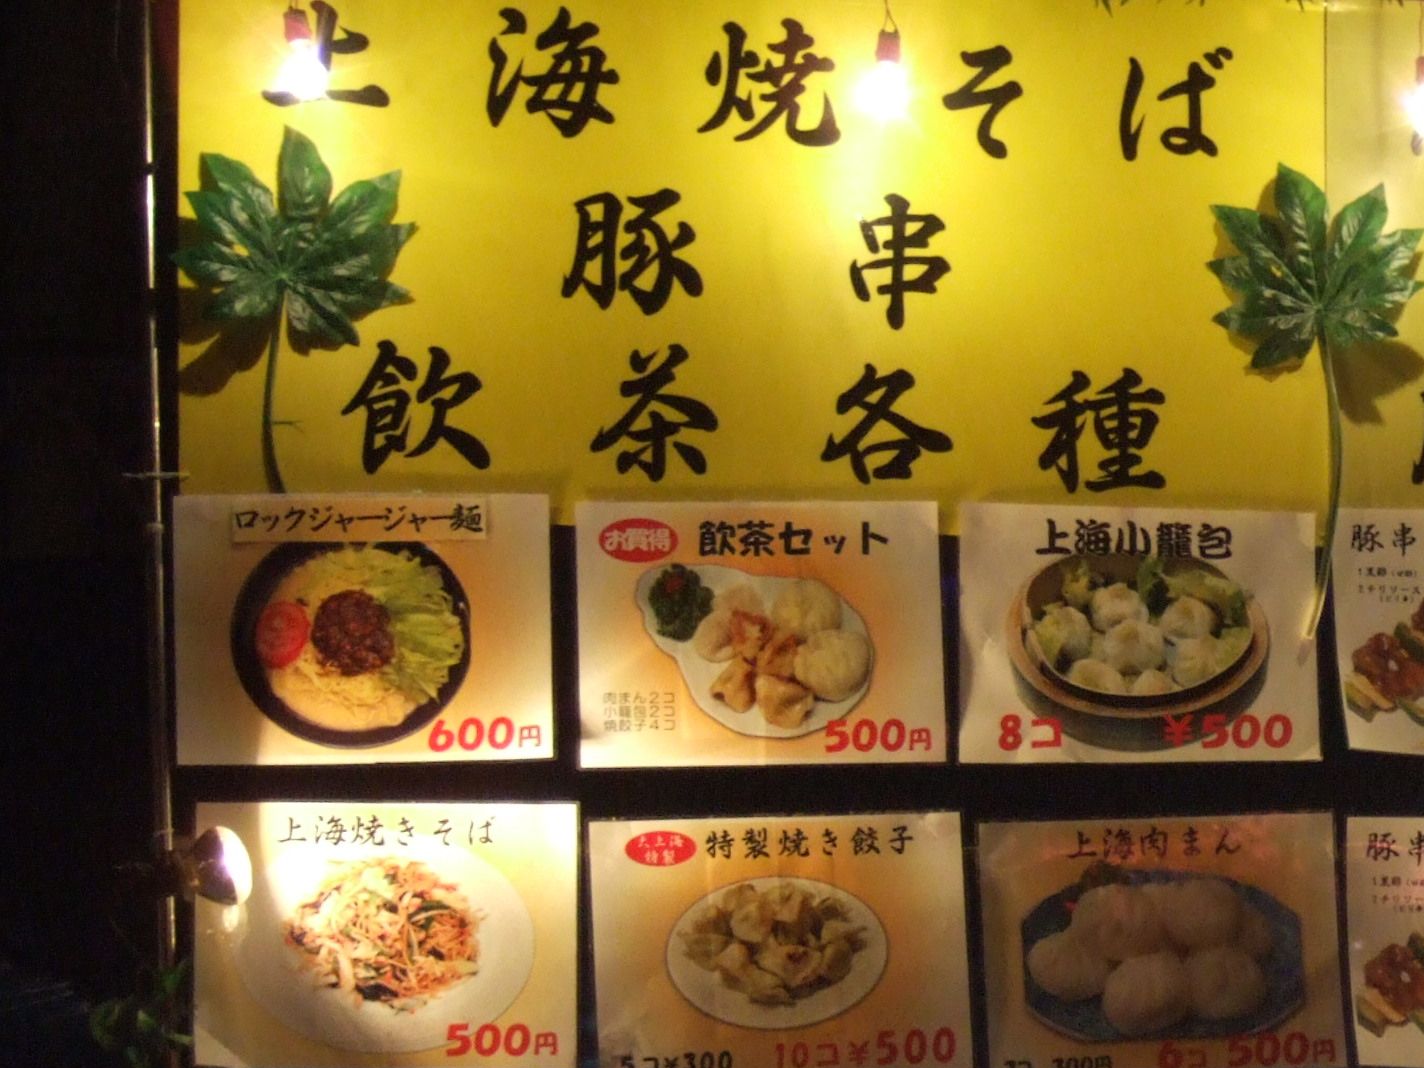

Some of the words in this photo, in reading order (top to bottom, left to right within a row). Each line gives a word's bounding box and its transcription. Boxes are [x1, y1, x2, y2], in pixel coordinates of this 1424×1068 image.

[262, 4, 1233, 162] 上海焼そば
[560, 191, 953, 331] 豚串
[341, 340, 1167, 494] 飲茶各種
[234, 503, 485, 533] ロックジャージャー麺
[698, 520, 889, 557] 飲茶セット
[1036, 518, 1233, 560] 上海小籠包
[1351, 522, 1417, 557] 豚串
[427, 716, 542, 752] 600円
[823, 718, 933, 753] 500円
[999, 714, 1063, 751] 8コ
[1164, 712, 1294, 750] ¥500
[277, 815, 498, 846] 上海焼きそば
[705, 825, 915, 860] 特製焼き餃子
[1067, 828, 1242, 861] 上海肉まん
[445, 1022, 560, 1057] 500円
[1227, 1031, 1336, 1068] 500円
